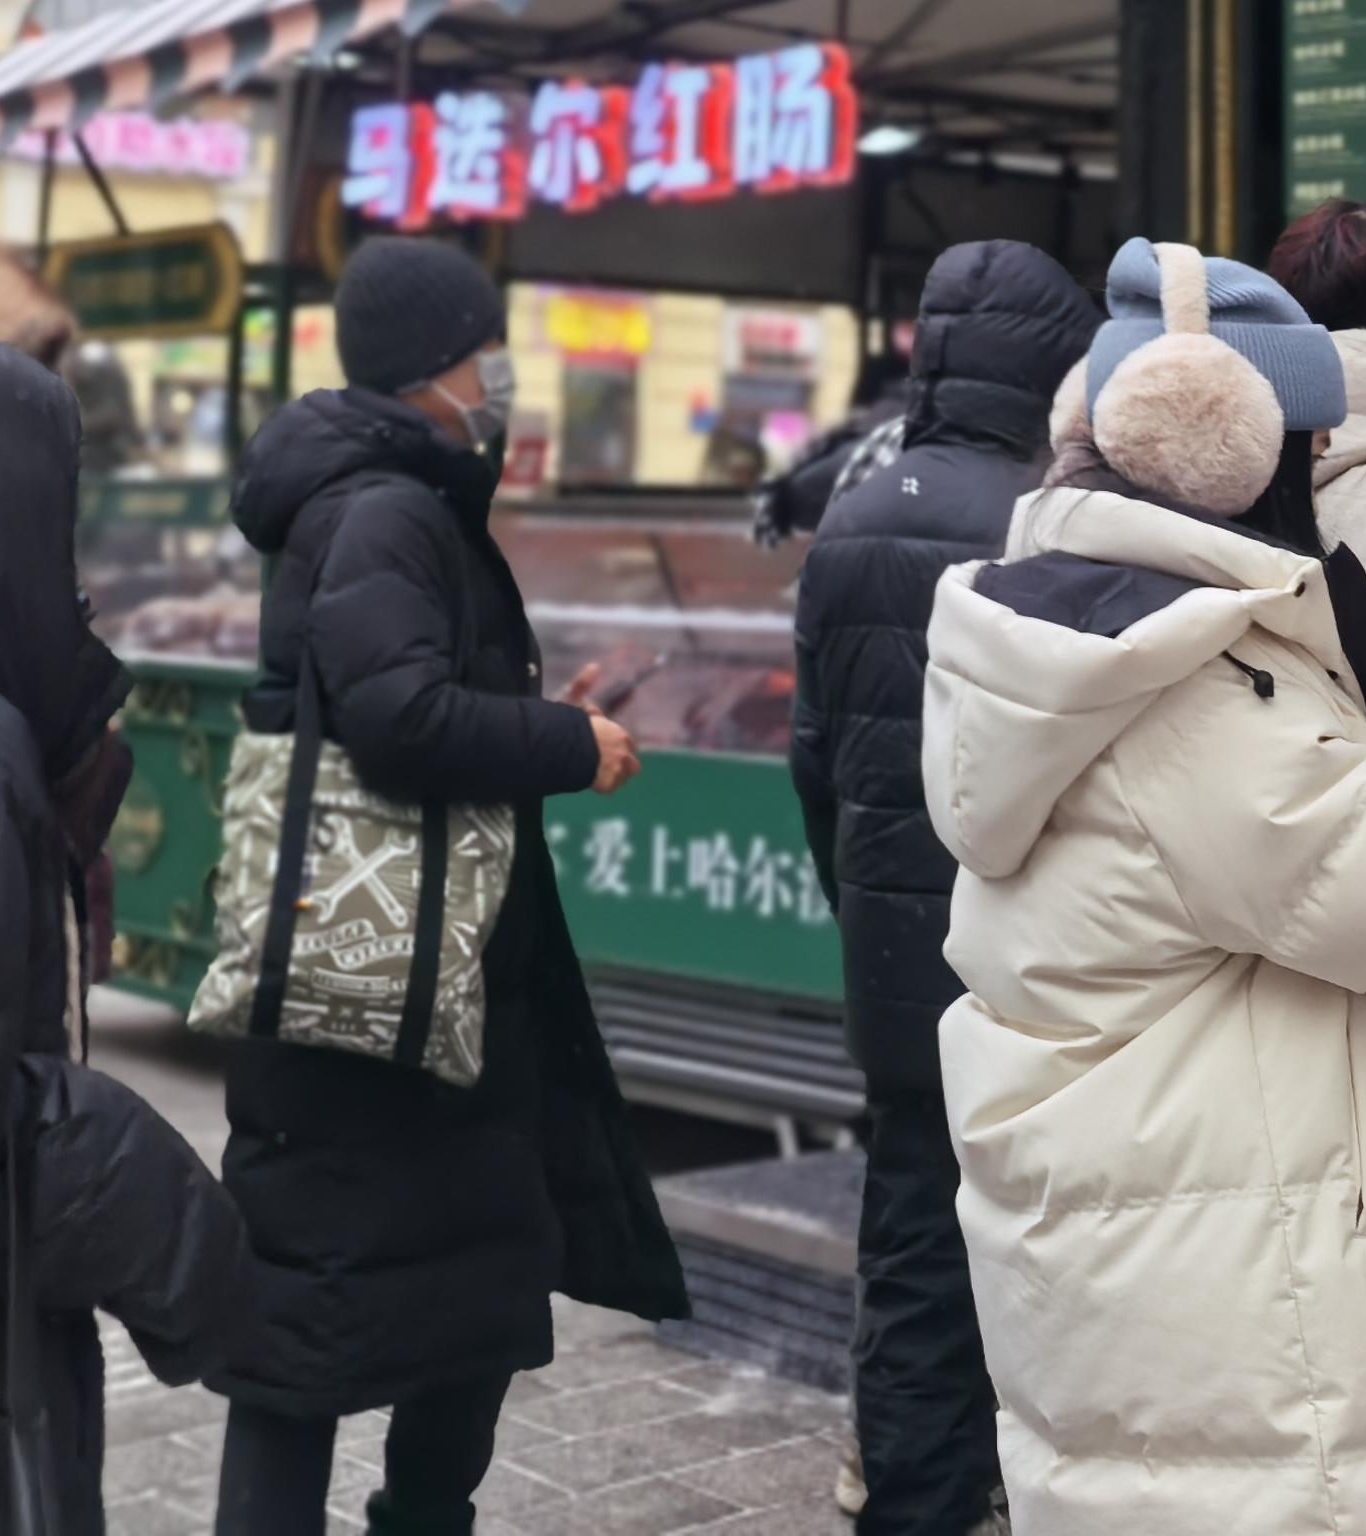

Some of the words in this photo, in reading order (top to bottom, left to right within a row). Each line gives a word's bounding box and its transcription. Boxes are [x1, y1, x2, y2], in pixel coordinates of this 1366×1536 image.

[342, 42, 851, 226] 马迭尔红肠
